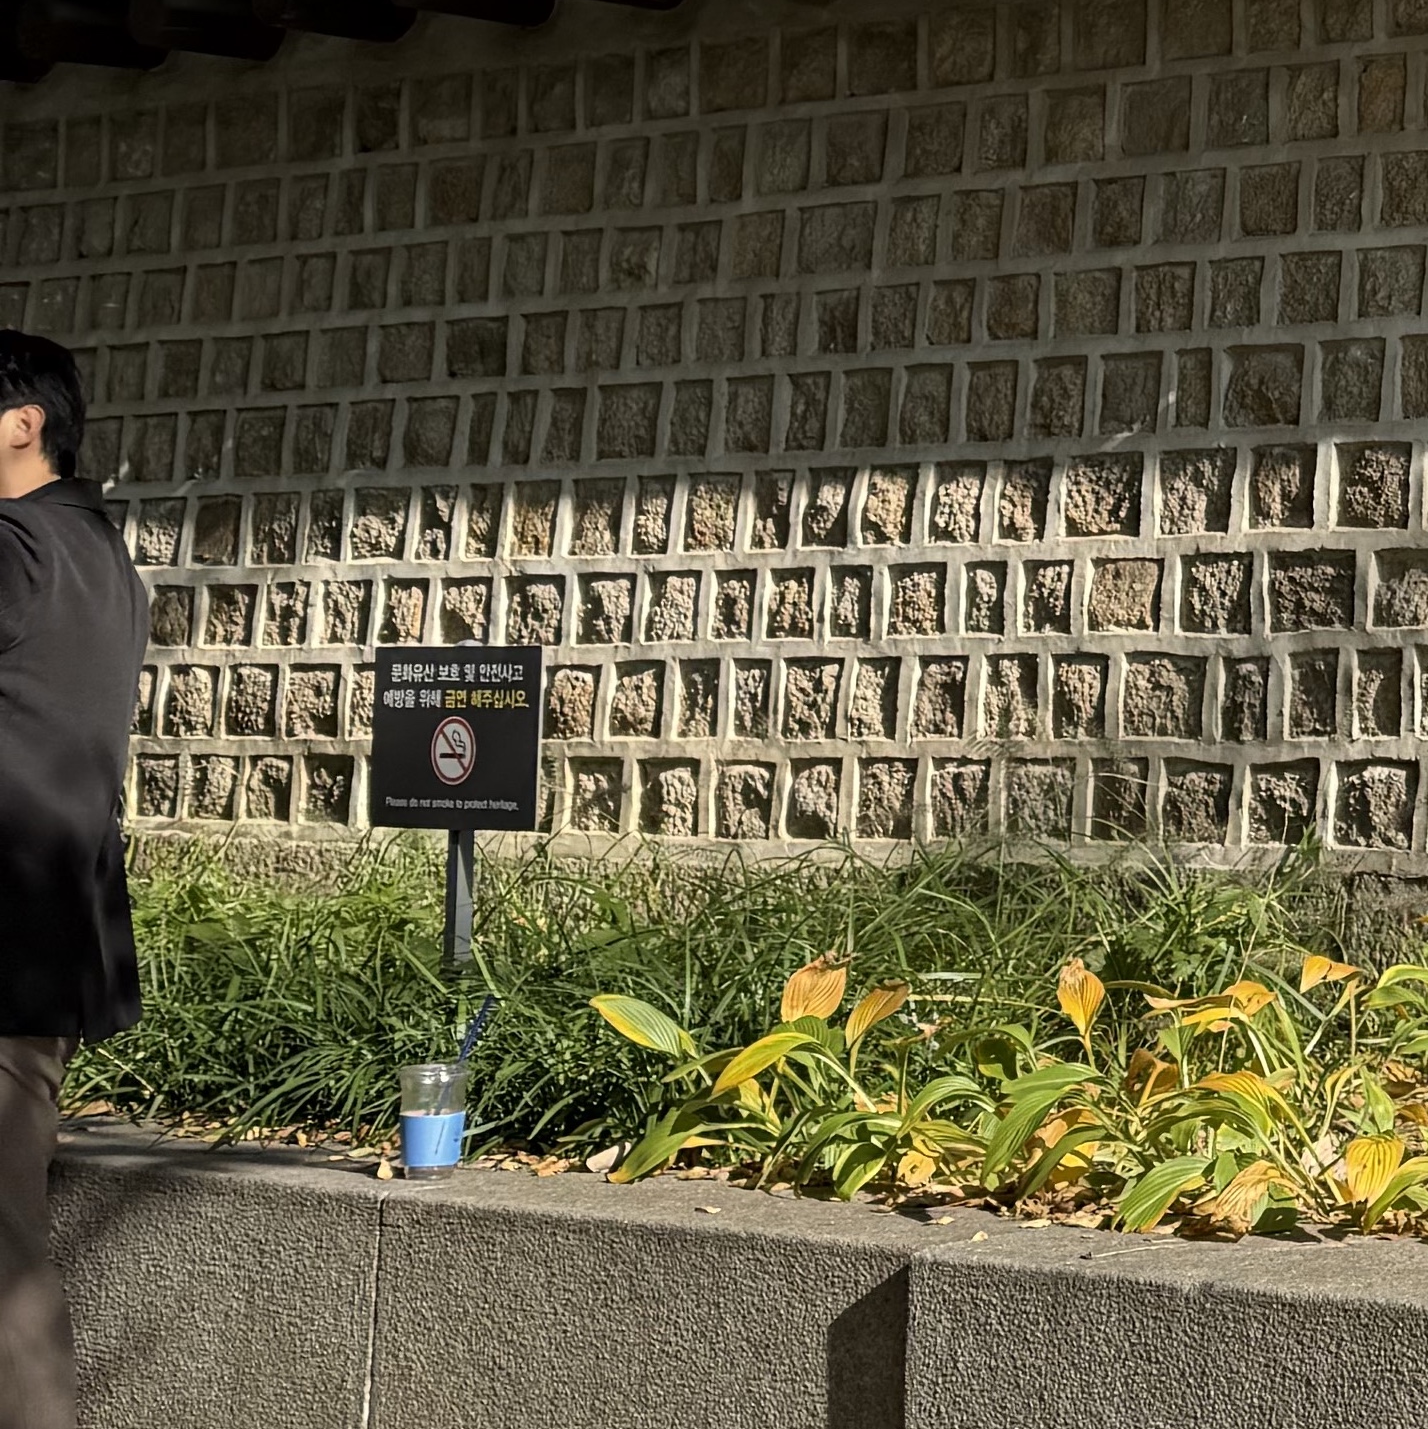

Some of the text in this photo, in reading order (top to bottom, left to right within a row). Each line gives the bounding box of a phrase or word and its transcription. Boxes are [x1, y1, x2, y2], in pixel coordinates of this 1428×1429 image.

[391, 663, 524, 682] 문화유산 보호 및 안전사고
[383, 689, 416, 708] 예방을
[419, 689, 441, 708] 위해
[444, 689, 467, 709] 금연
[386, 796, 408, 807] Please
[409, 797, 419, 808] do
[420, 799, 431, 808] not
[432, 798, 454, 809] smoke
[455, 799, 463, 809] to
